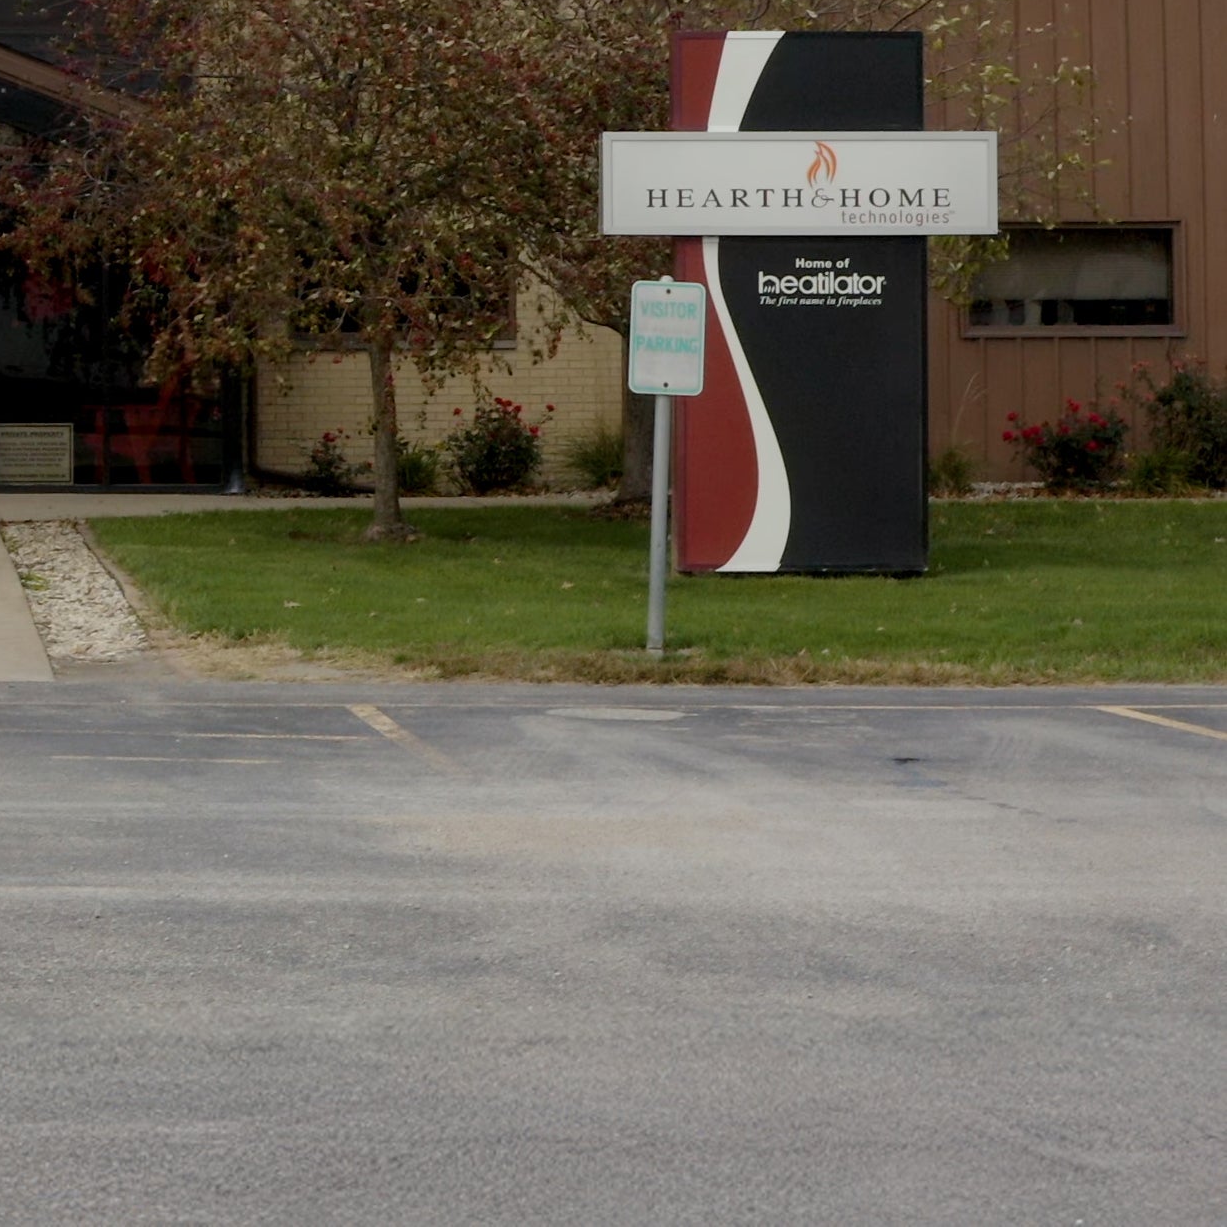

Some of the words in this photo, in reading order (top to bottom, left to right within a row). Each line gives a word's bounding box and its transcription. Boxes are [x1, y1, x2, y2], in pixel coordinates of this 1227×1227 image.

[795, 257, 833, 269] Home
[835, 257, 851, 269] of
[760, 296, 776, 305] The
[777, 296, 798, 308] first
[799, 298, 824, 306] name
[826, 297, 836, 306] in
[836, 296, 882, 308] fireplaces
[641, 301, 698, 319] VISITOR
[634, 334, 699, 354] PARKING
